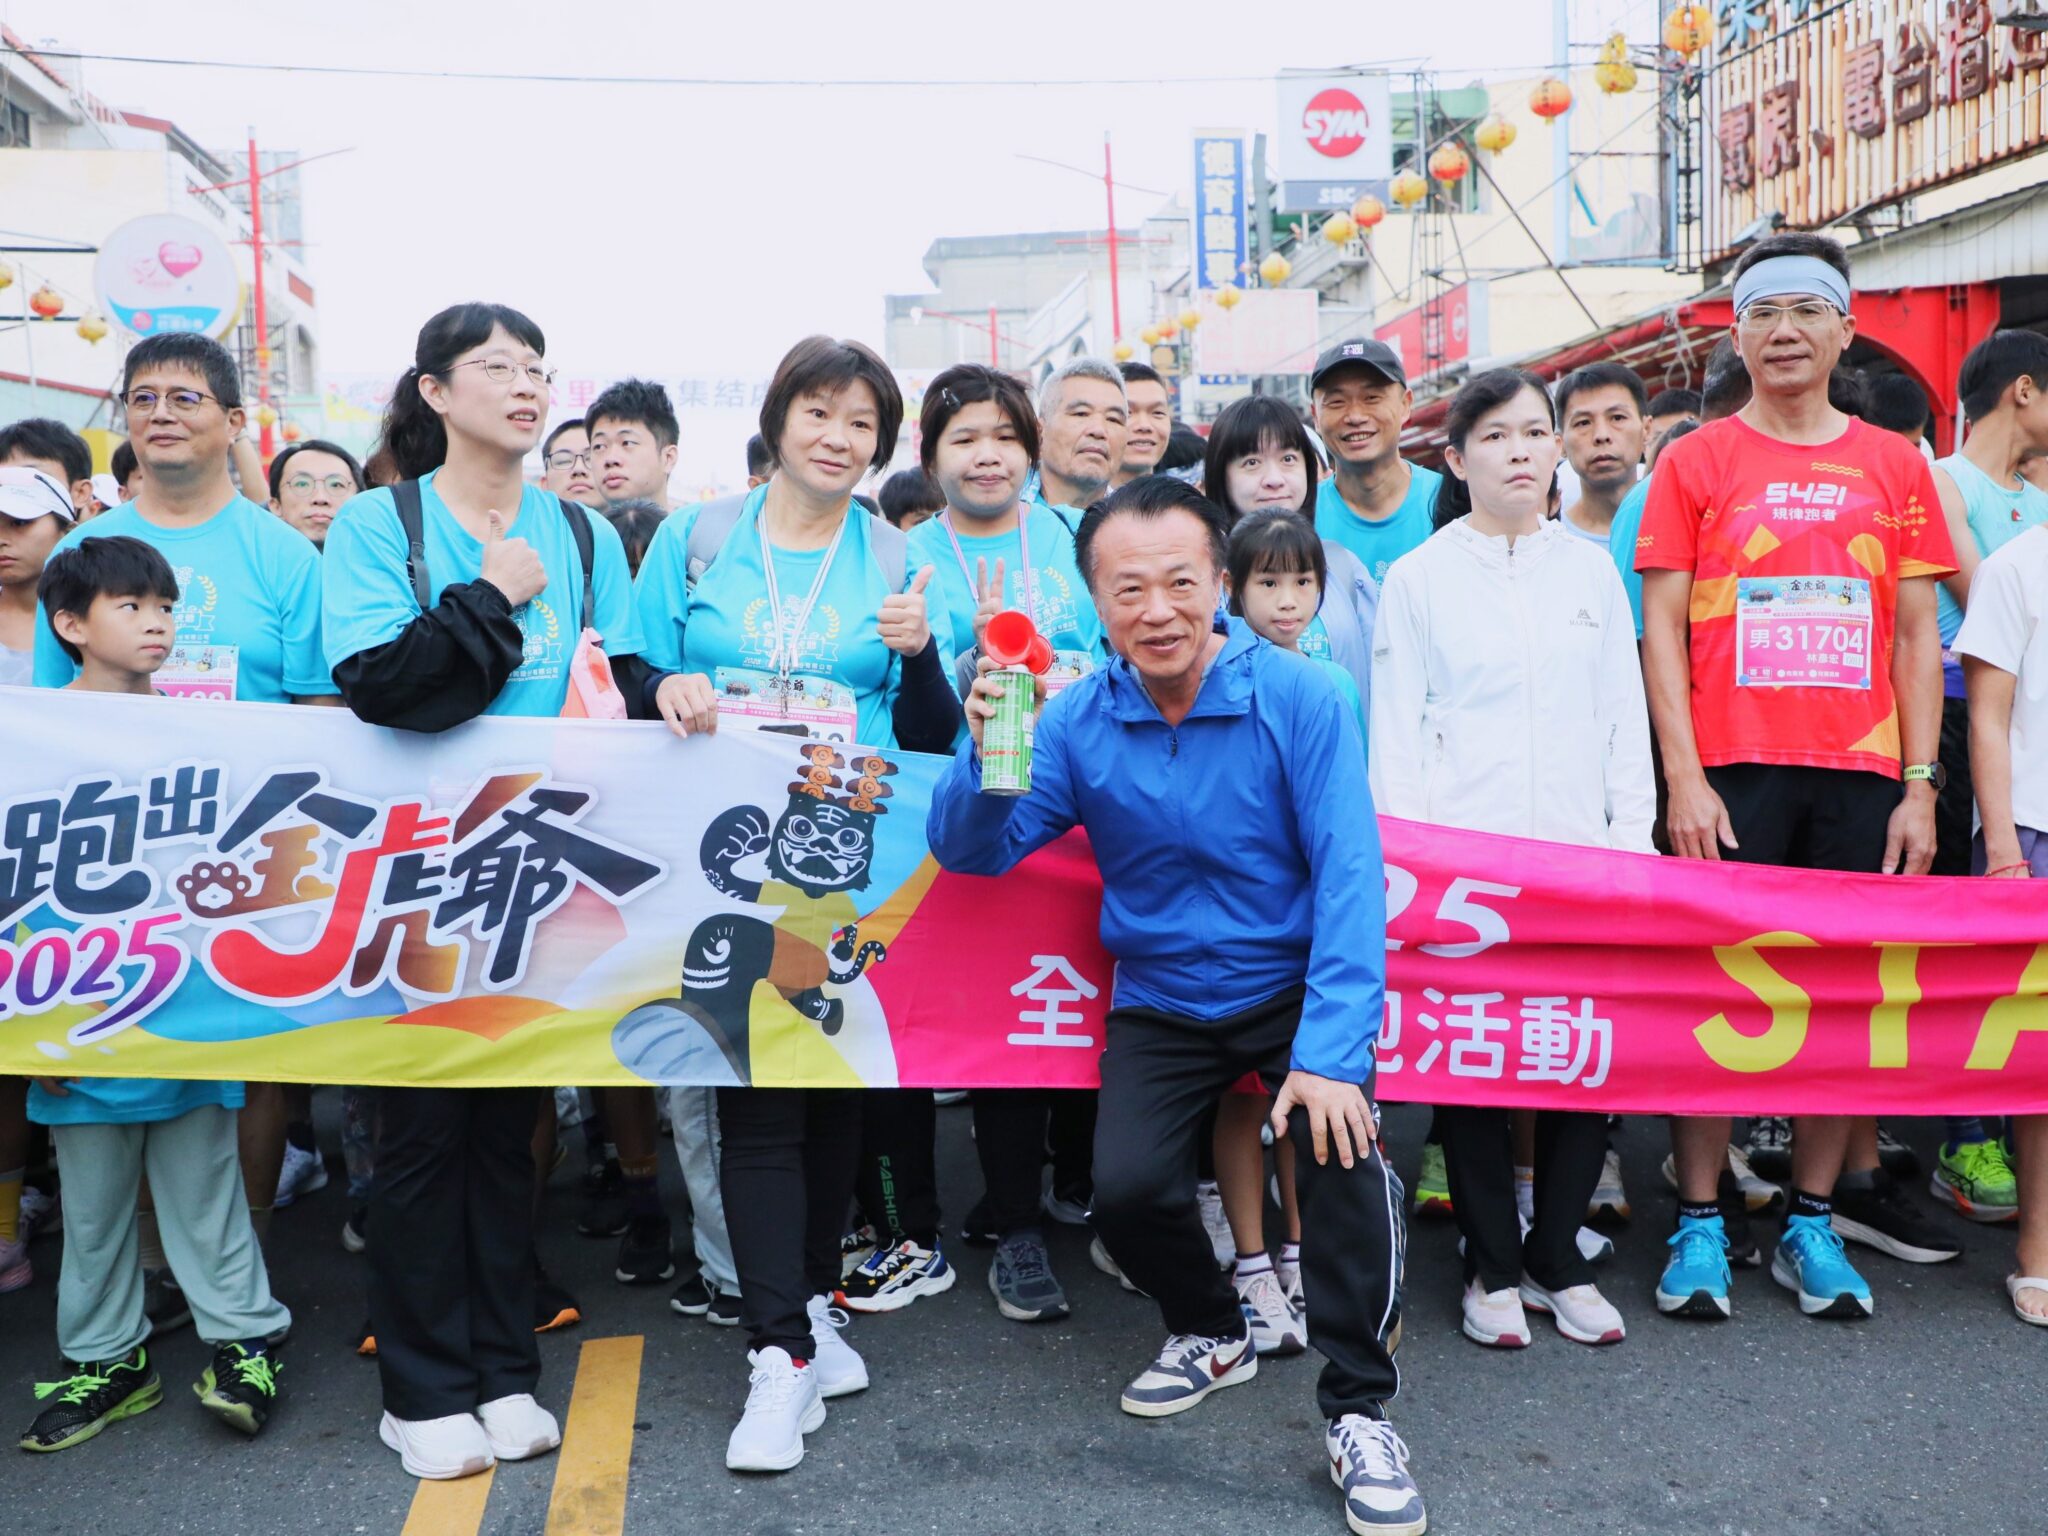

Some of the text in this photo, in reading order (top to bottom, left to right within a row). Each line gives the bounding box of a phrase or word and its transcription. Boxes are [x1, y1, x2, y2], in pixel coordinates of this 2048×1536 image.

[1301, 110, 1369, 145] SYM
[1773, 507, 1837, 522] 規律跑者
[1749, 625, 1864, 653] 男 31704
[1006, 954, 1099, 1047] 全
